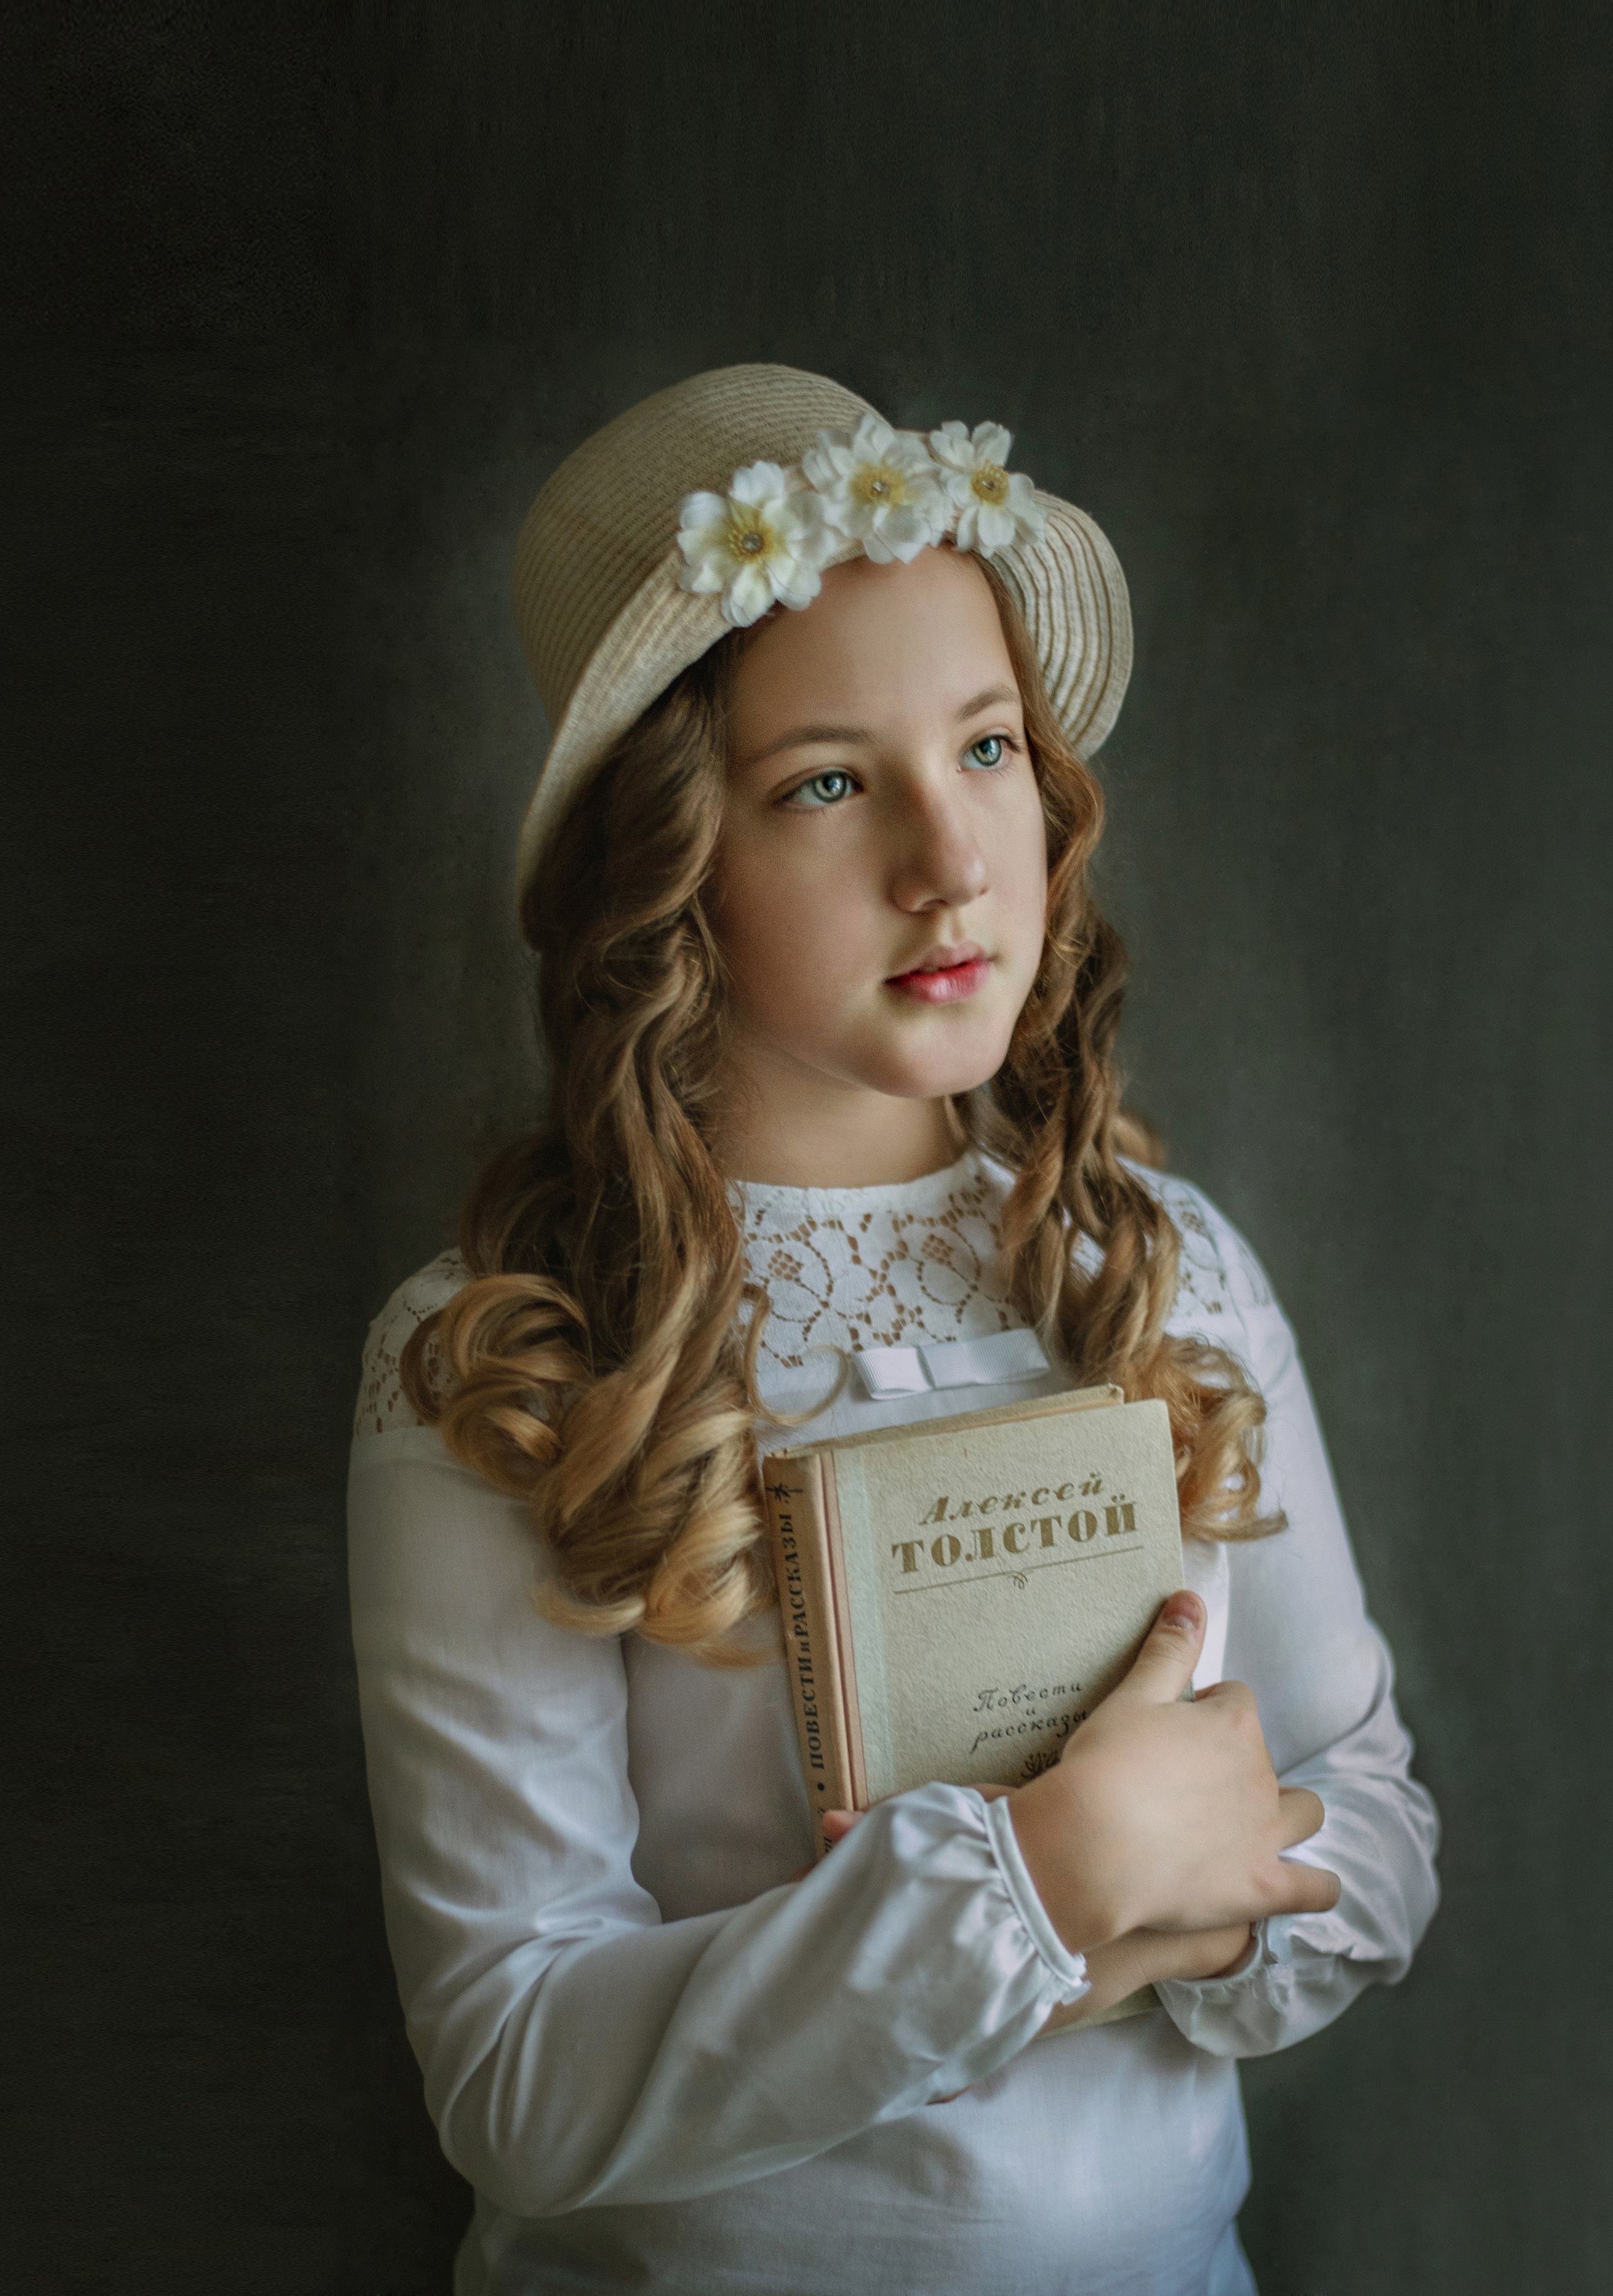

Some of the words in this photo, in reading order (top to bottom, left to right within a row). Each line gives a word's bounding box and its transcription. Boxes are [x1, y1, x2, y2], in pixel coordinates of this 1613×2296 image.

[919, 1471, 1104, 1526] Алексей
[891, 1493, 1139, 1574] ТОЛСТОЙ
[779, 1514, 809, 1639] РАССКАЗЫ
[797, 1656, 825, 1770] ПОВЕСТИ
[973, 1683, 1082, 1712] Повести
[1026, 1706, 1036, 1716] и
[969, 1710, 1088, 1756] рассказы
